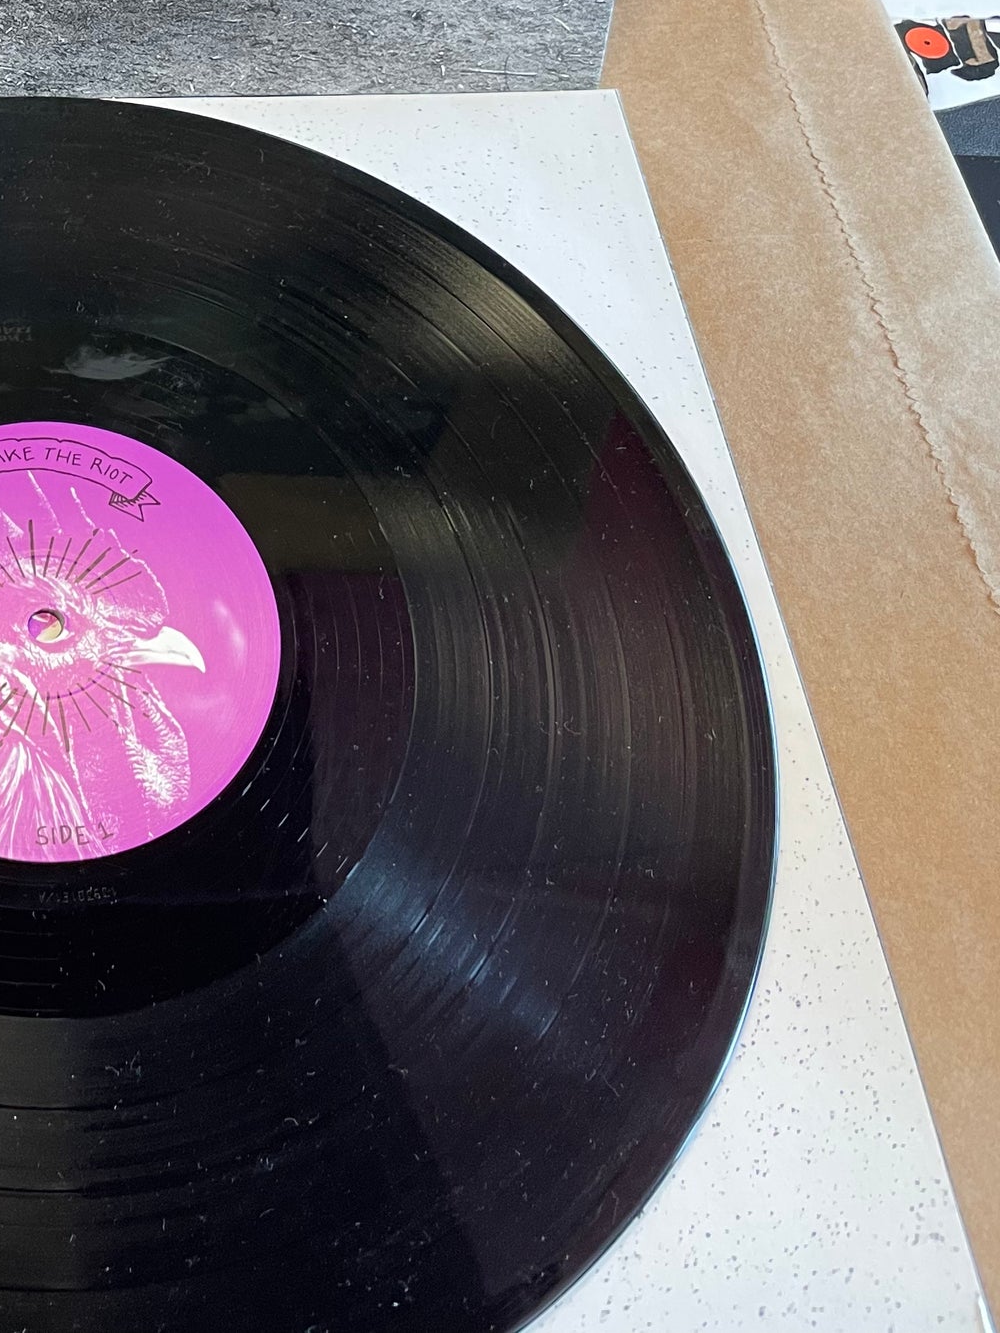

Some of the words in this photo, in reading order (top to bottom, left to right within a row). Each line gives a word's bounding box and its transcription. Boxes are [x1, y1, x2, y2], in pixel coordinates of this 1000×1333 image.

[45, 447, 82, 467] THE
[90, 457, 133, 485] RIOT
[35, 826, 90, 845] SIDE
[97, 822, 114, 840] 1
